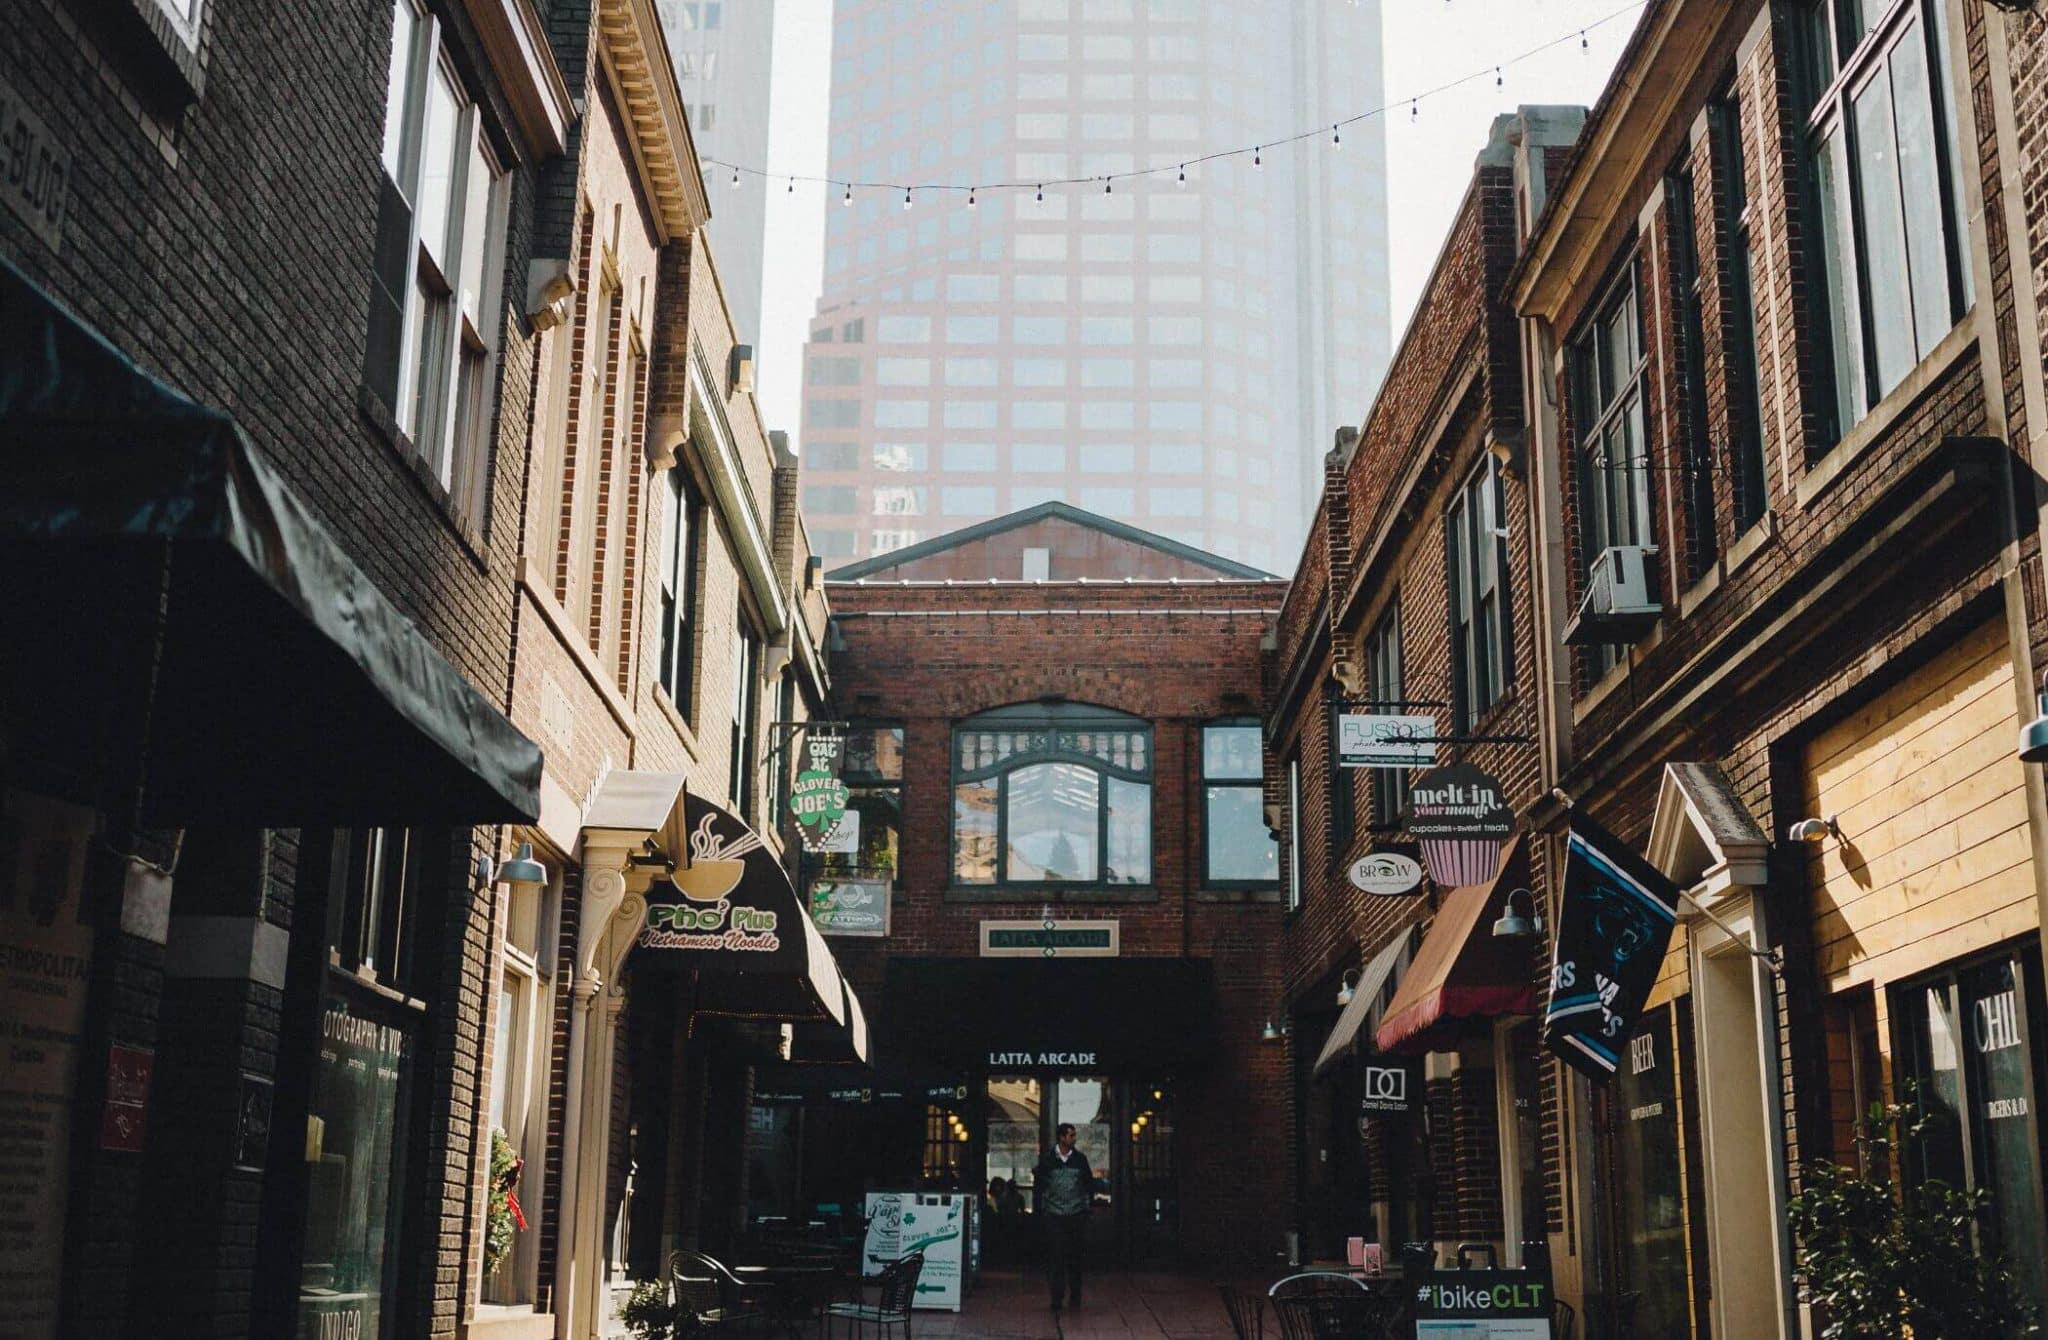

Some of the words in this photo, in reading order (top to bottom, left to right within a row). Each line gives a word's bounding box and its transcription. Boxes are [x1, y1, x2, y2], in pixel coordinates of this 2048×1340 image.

[793, 778, 841, 794] CLOVER
[792, 791, 847, 816] JOE'S
[731, 906, 777, 931] Plus
[640, 927, 723, 949] Vietnamese
[723, 928, 780, 951] Noodle
[989, 1052, 1033, 1065] LATTA
[1037, 1052, 1097, 1065] ARCADE
[1630, 1032, 1656, 1075] BEER
[1416, 1283, 1544, 1310] #ibikeCLT
